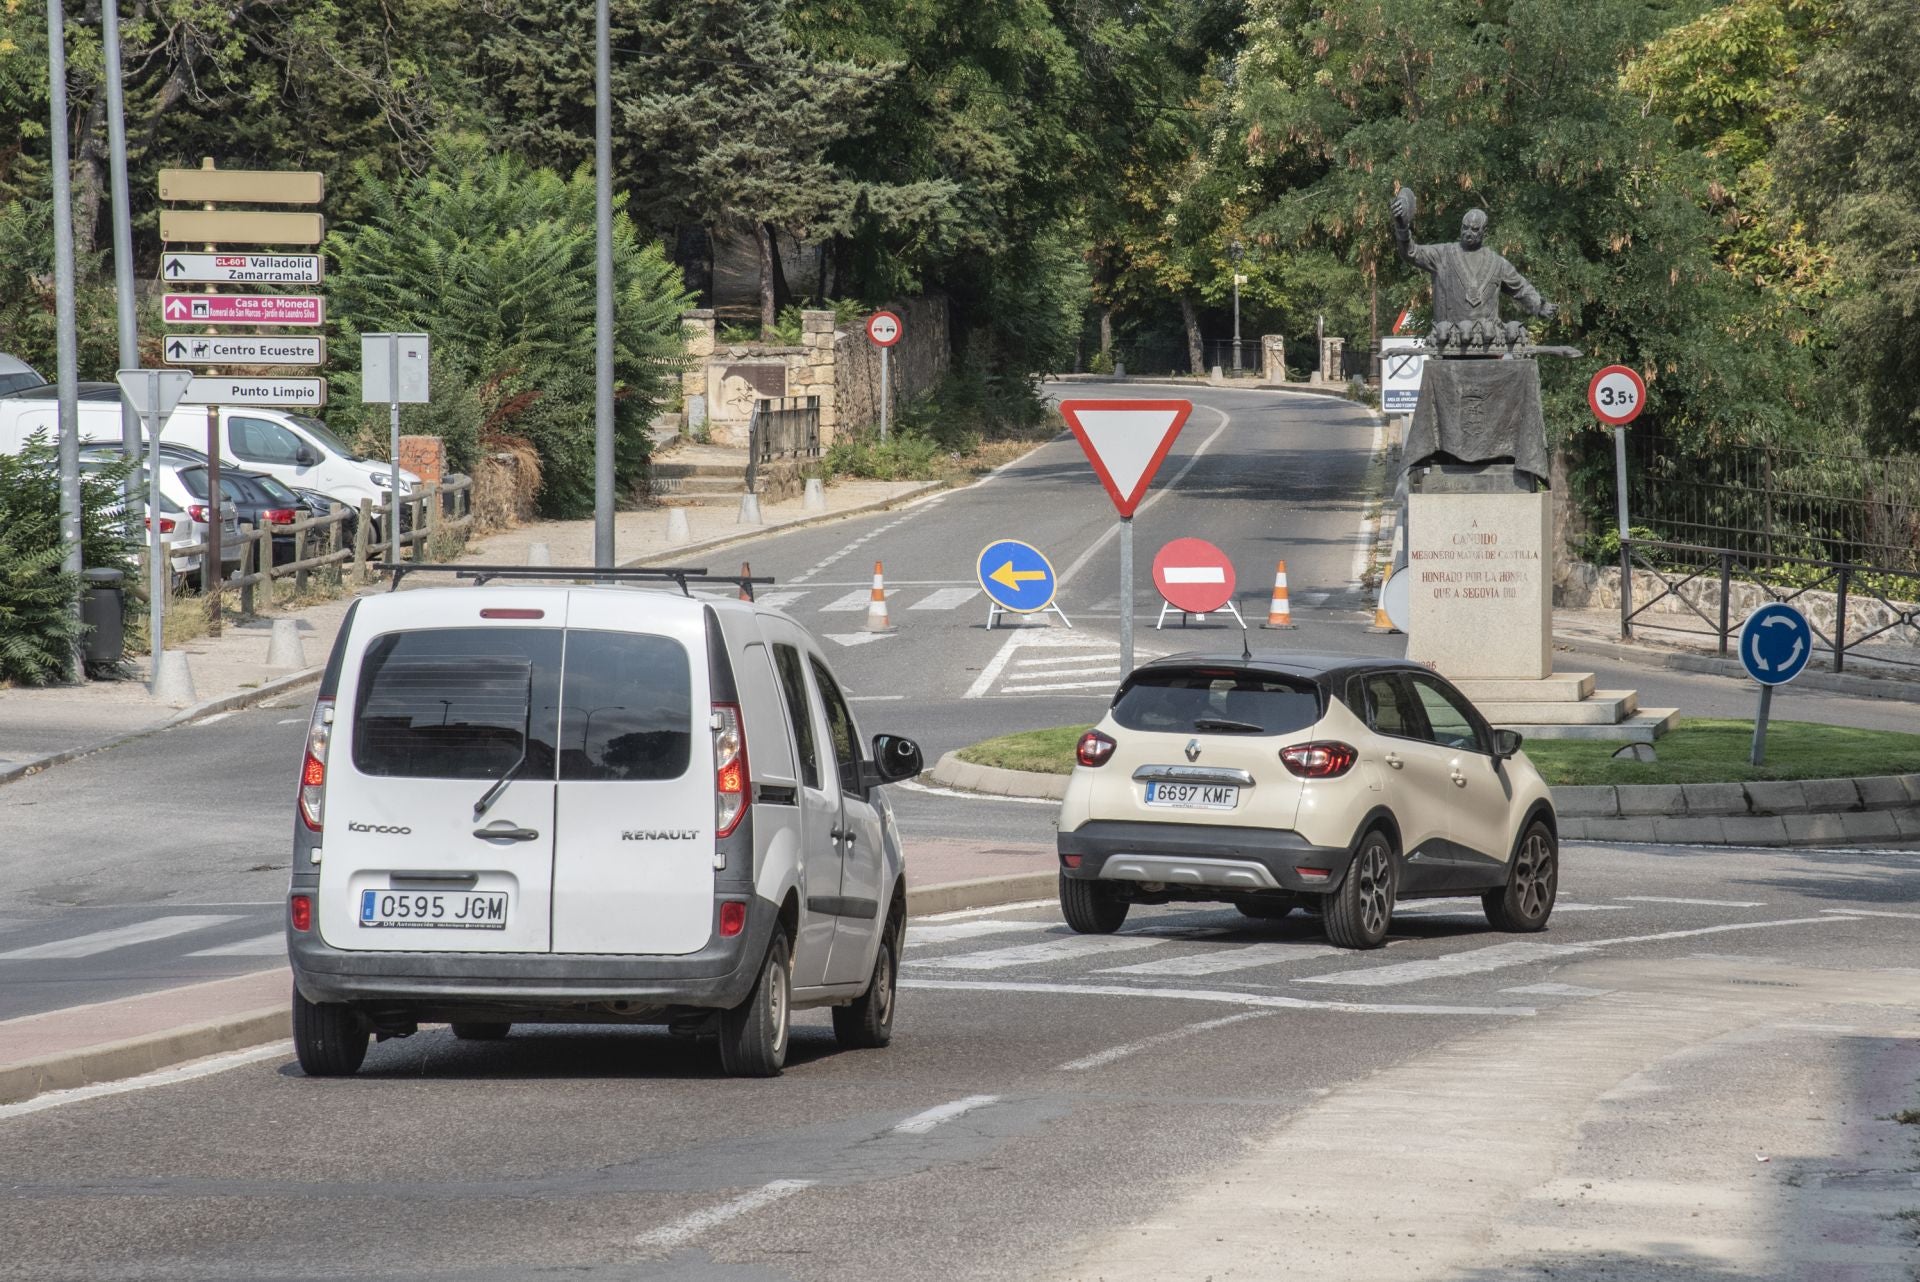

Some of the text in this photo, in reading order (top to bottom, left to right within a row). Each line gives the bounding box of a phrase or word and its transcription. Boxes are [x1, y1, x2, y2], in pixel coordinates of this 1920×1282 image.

[216, 257, 312, 268] CL-601 Valladolid
[229, 269, 312, 280] Zamarramala
[235, 298, 315, 308] Casa de Moneda
[213, 345, 314, 356] Centro Ecuestre
[232, 386, 315, 399] Punto Limpio
[1472, 520, 1478, 528] A
[1411, 551, 1455, 560] MESONERO
[1485, 551, 1496, 560] DE
[1422, 571, 1462, 582] HONRADO
[1433, 587, 1451, 598] QUE
[1454, 588, 1460, 598] A
[1462, 587, 1499, 598] SEGOVIA
[1158, 785, 1198, 801] 6697
[1203, 786, 1234, 803] KMF
[621, 829, 701, 841] RENAULT
[381, 895, 445, 918] 0595
[455, 896, 503, 920] JGM
